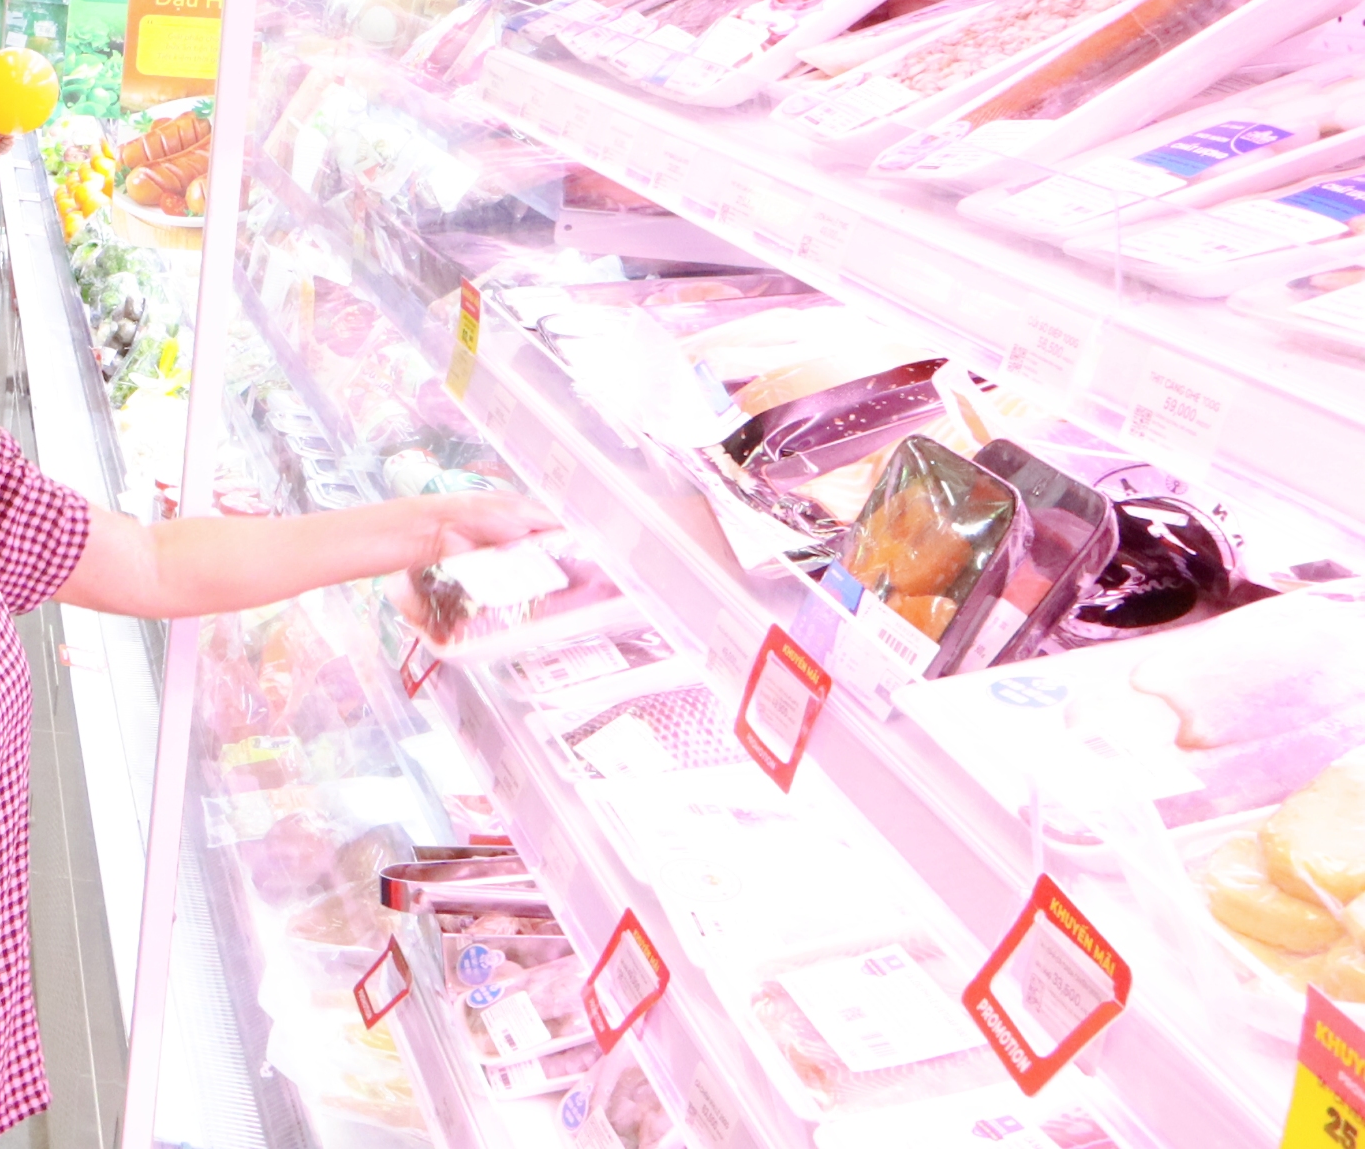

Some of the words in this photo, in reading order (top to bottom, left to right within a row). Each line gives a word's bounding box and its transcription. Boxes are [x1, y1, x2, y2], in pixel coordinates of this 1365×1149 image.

[1163, 395, 1197, 422] 59,000
[1050, 897, 1094, 952] KHUYẾN
[976, 997, 1032, 1074] PROMOTION
